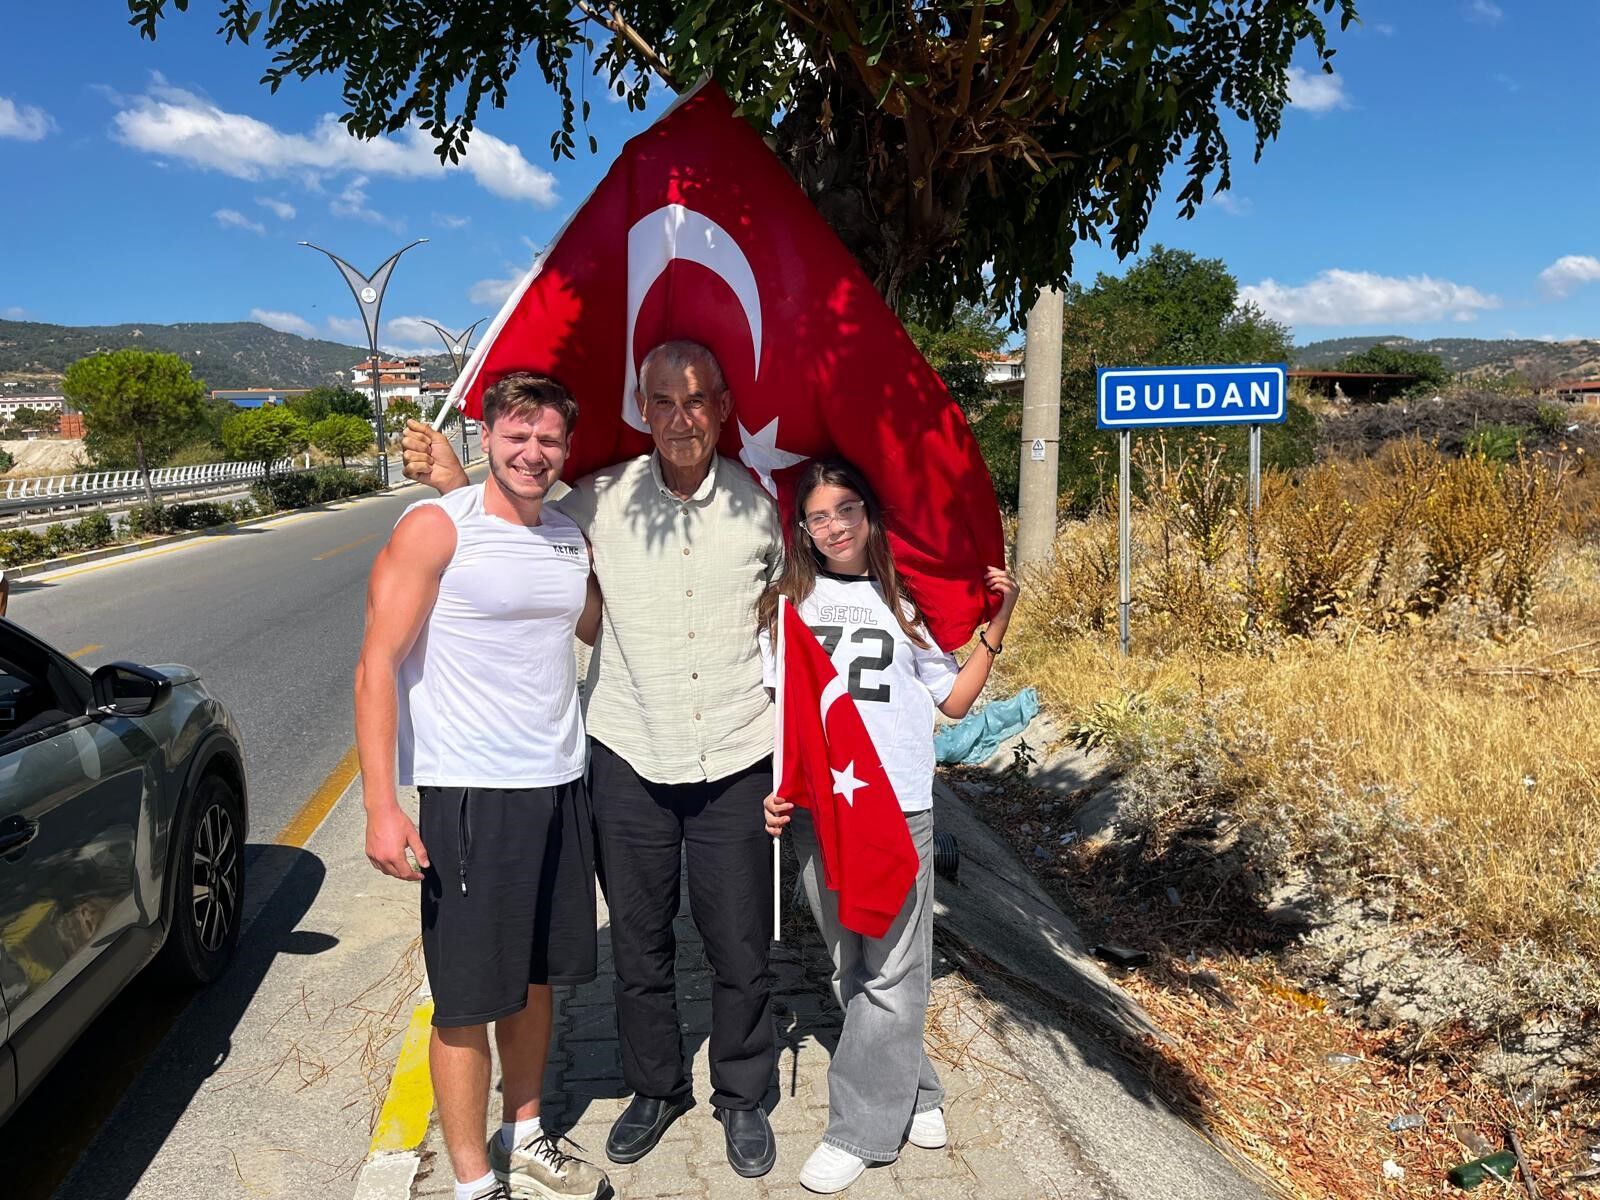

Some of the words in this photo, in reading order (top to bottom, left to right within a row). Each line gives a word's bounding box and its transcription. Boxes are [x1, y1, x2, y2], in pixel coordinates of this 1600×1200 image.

[1116, 381, 1270, 411] BULDAN
[820, 606, 877, 625] SEUL
[809, 626, 894, 703] 72
